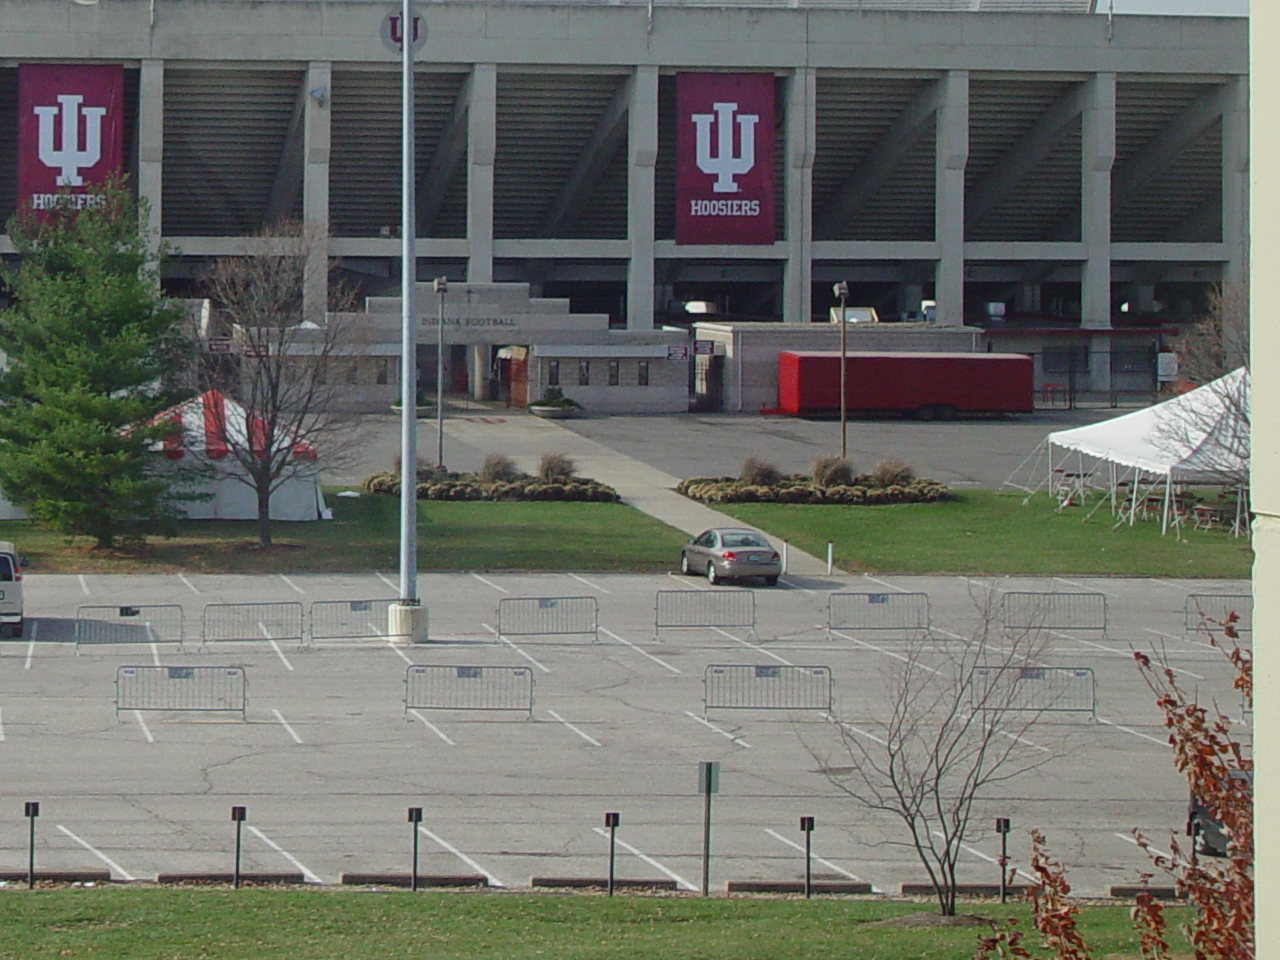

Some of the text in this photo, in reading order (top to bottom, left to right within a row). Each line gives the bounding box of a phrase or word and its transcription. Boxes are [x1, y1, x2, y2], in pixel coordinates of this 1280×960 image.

[33, 94, 107, 187] IU
[691, 102, 760, 193] IU
[32, 193, 107, 210] HOOIERS
[690, 200, 760, 216] HOOSIERS
[422, 317, 516, 327] INDANA FOOTBALL
